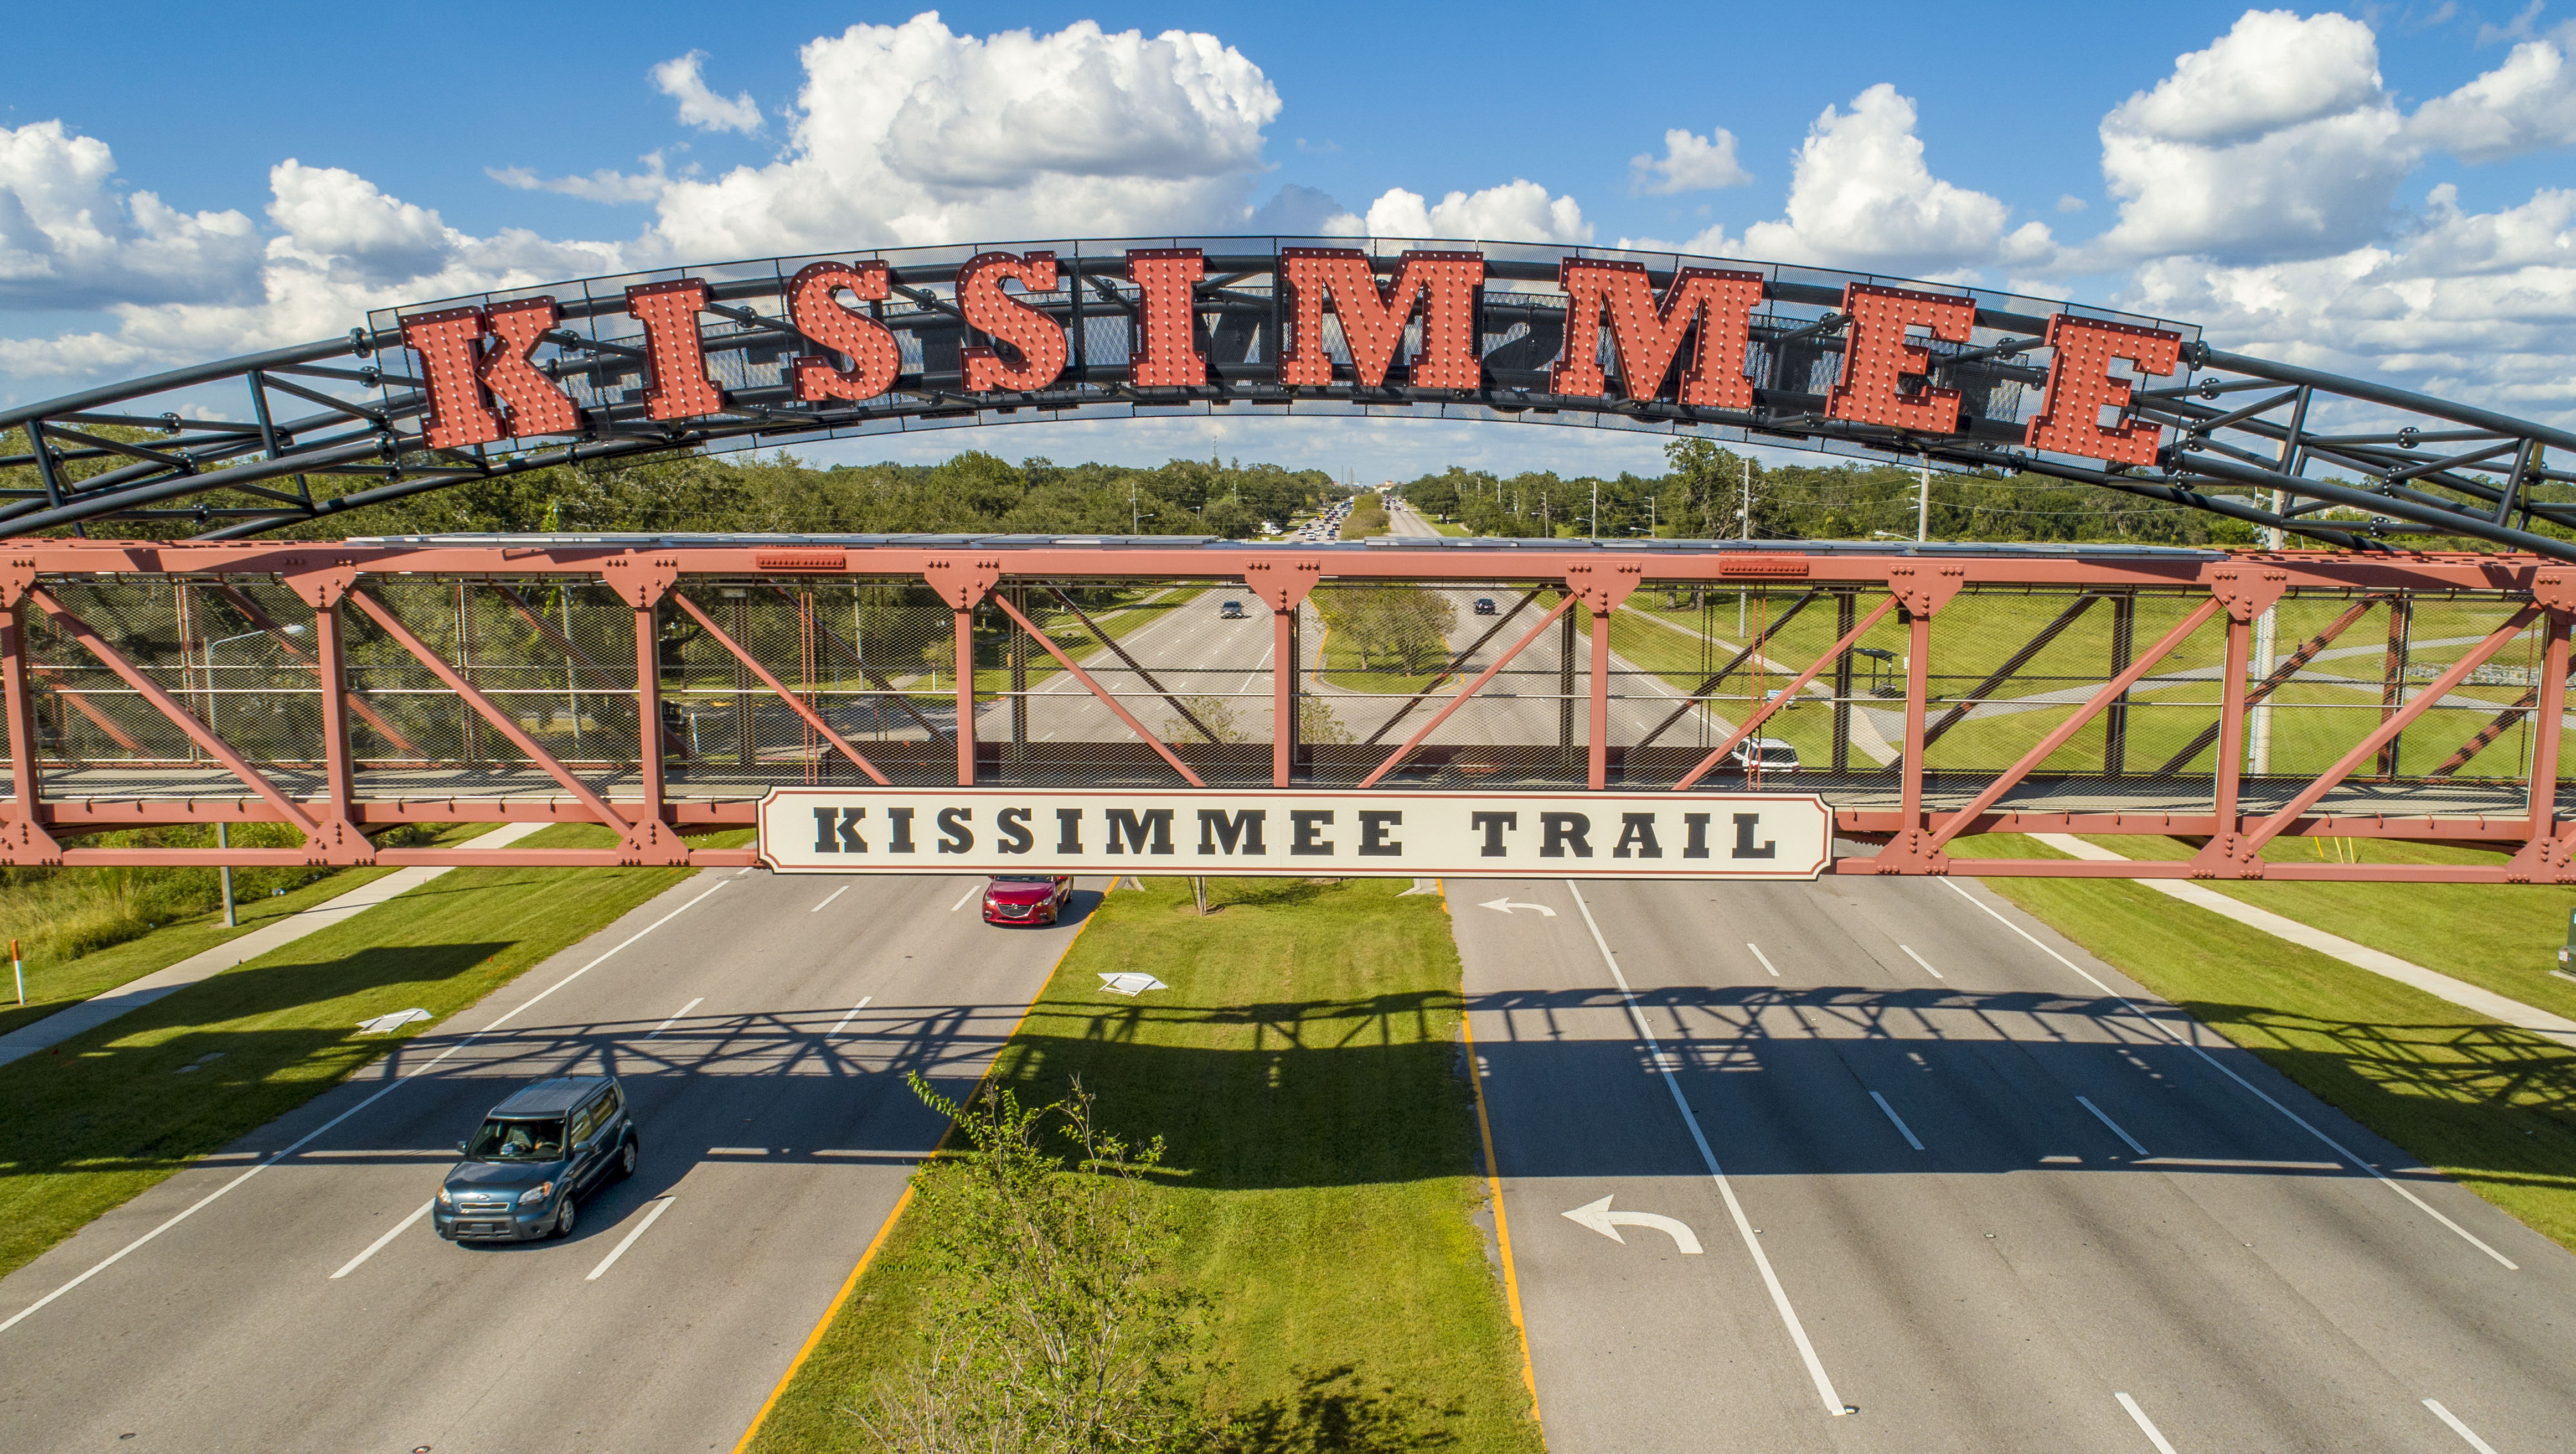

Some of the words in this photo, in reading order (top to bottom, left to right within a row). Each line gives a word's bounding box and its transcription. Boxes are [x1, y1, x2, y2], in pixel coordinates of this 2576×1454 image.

[400, 248, 2184, 468] KISSIMMEE
[814, 808, 1402, 856] KISSIMMEE
[1472, 811, 1775, 858] TRAIL
